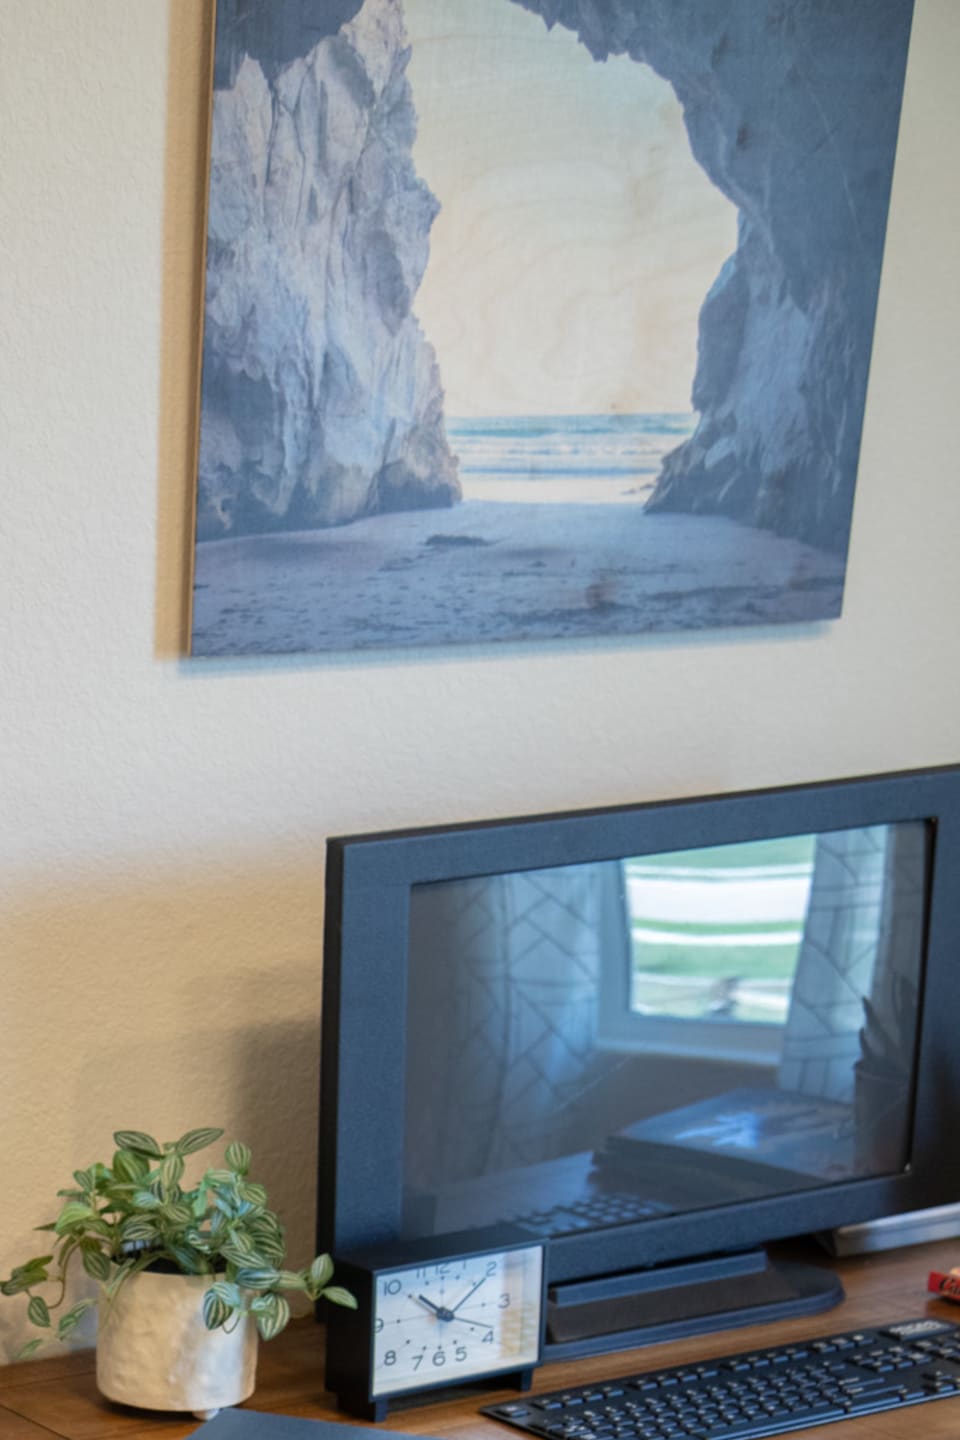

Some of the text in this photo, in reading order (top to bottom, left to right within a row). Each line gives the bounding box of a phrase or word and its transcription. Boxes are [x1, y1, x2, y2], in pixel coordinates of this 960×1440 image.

[486, 1260, 497, 1276] 2
[383, 1279, 402, 1296] 10
[498, 1293, 511, 1309] 3
[481, 1330, 495, 1344] 4
[383, 1350, 397, 1367] 8
[432, 1350, 446, 1367] 6
[455, 1346, 467, 1362] 5
[411, 1354, 424, 1371] 7
